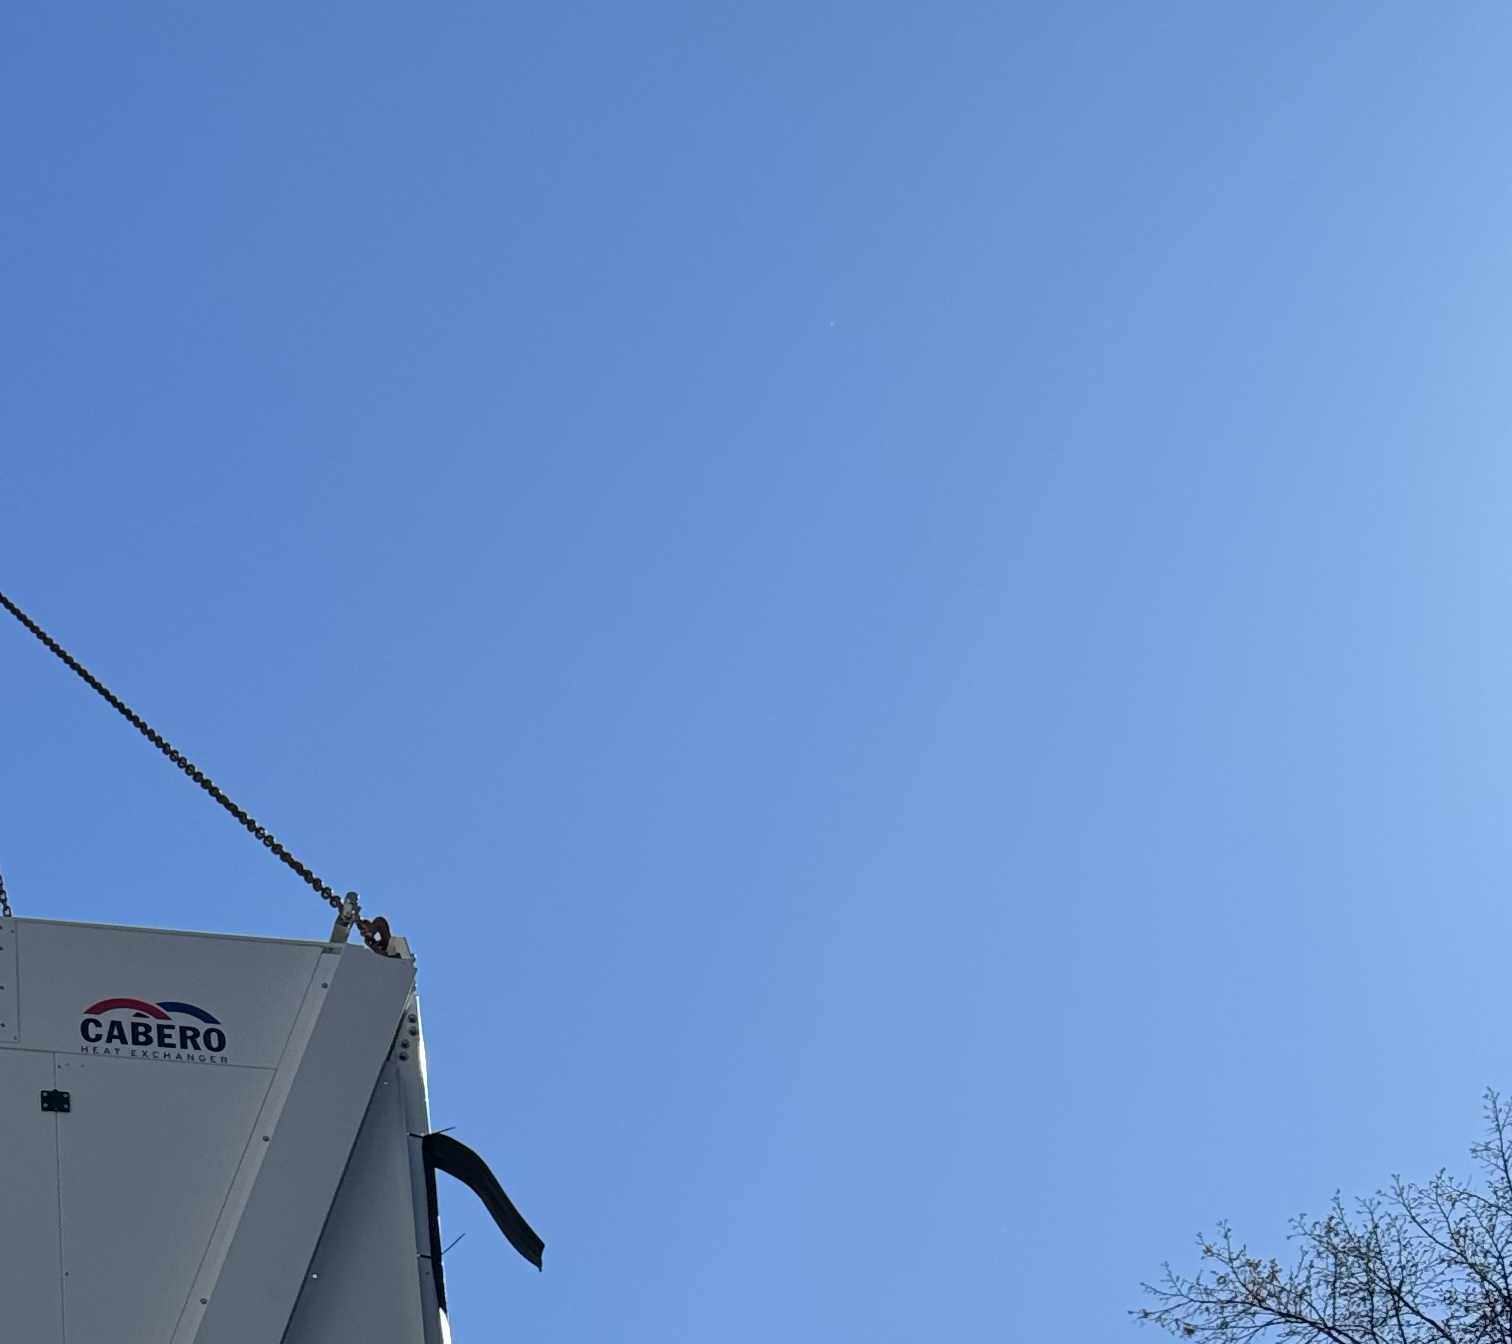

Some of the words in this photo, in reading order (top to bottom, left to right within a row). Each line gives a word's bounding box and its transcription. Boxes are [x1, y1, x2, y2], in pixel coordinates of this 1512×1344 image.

[80, 1017, 227, 1053] CABERO
[80, 1045, 120, 1056] HEAT
[130, 1049, 229, 1064] EXCHANGER
